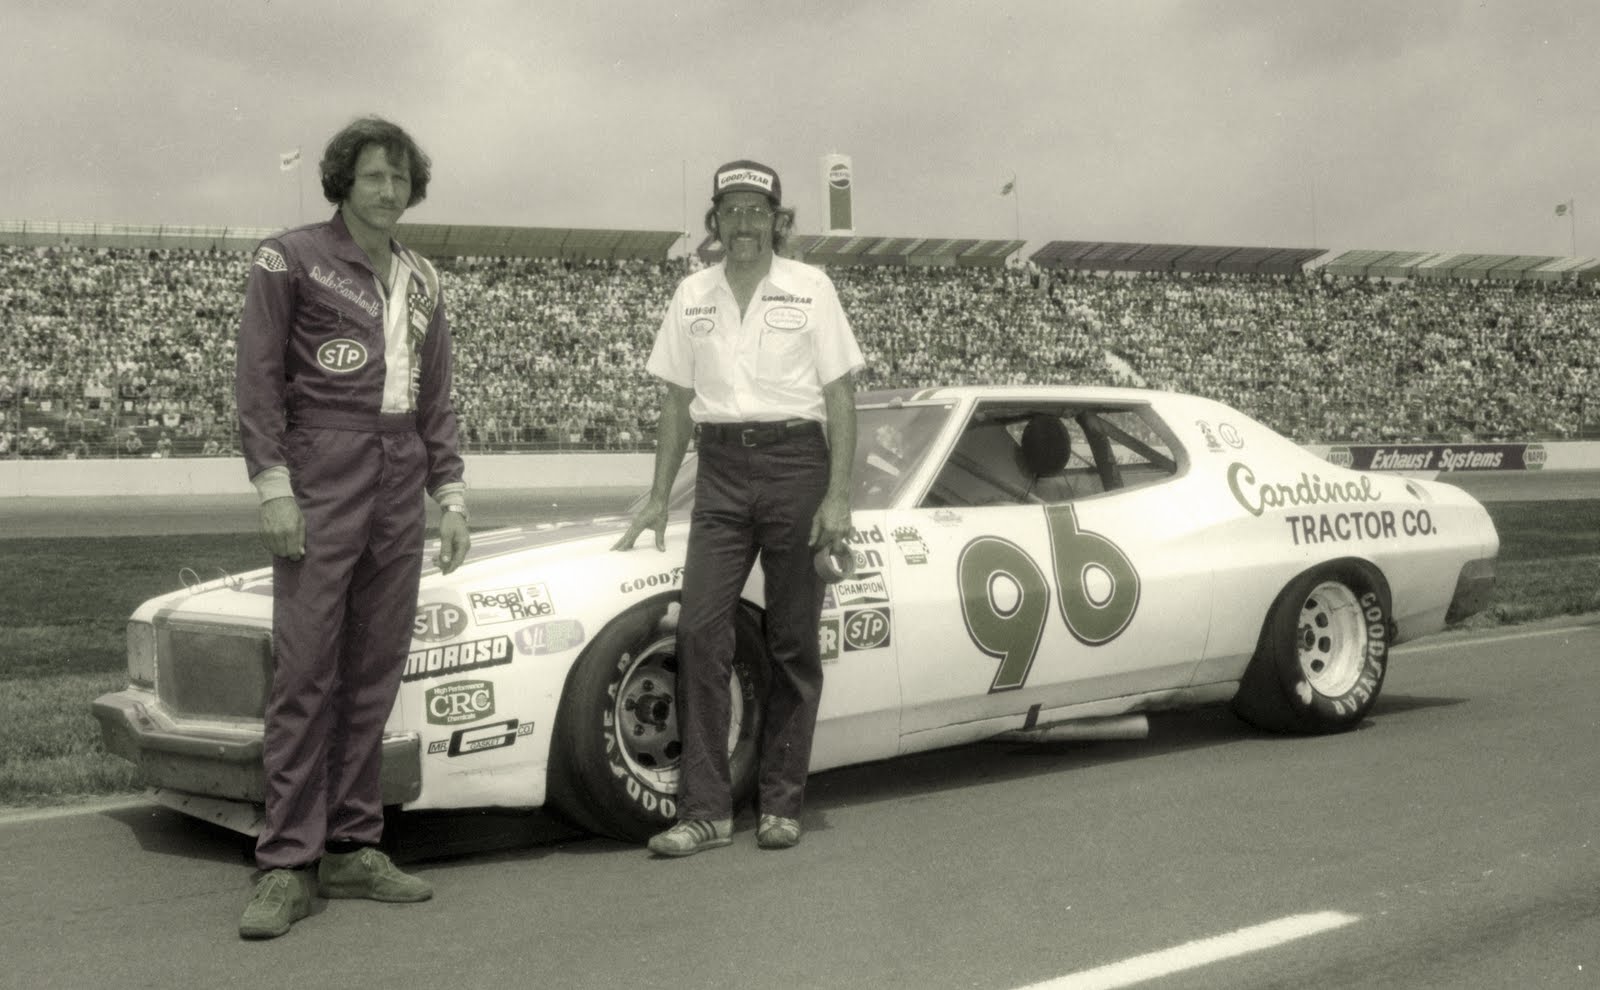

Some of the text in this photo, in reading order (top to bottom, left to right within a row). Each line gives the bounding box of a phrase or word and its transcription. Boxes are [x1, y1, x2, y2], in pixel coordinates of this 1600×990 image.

[720, 172, 769, 185] GOODYEAR
[309, 266, 335, 289] Dale
[761, 295, 813, 304] GOODYEAR
[324, 344, 360, 367] STP
[1370, 449, 1433, 470] Exhaust
[1438, 448, 1503, 472] Systems
[1227, 462, 1381, 517] Cardinal
[1286, 508, 1437, 545] TRACTOR CO.
[470, 587, 524, 609] Regal
[838, 581, 884, 599] CHAMPION
[957, 503, 1141, 694] 96
[413, 604, 460, 635] STP
[510, 599, 552, 620] Ride
[850, 613, 883, 640] STP
[402, 636, 509, 677] MOROSO
[1332, 592, 1385, 716] GOODYEAR
[430, 689, 491, 717] CRC
[606, 652, 677, 818] OODYEAR
